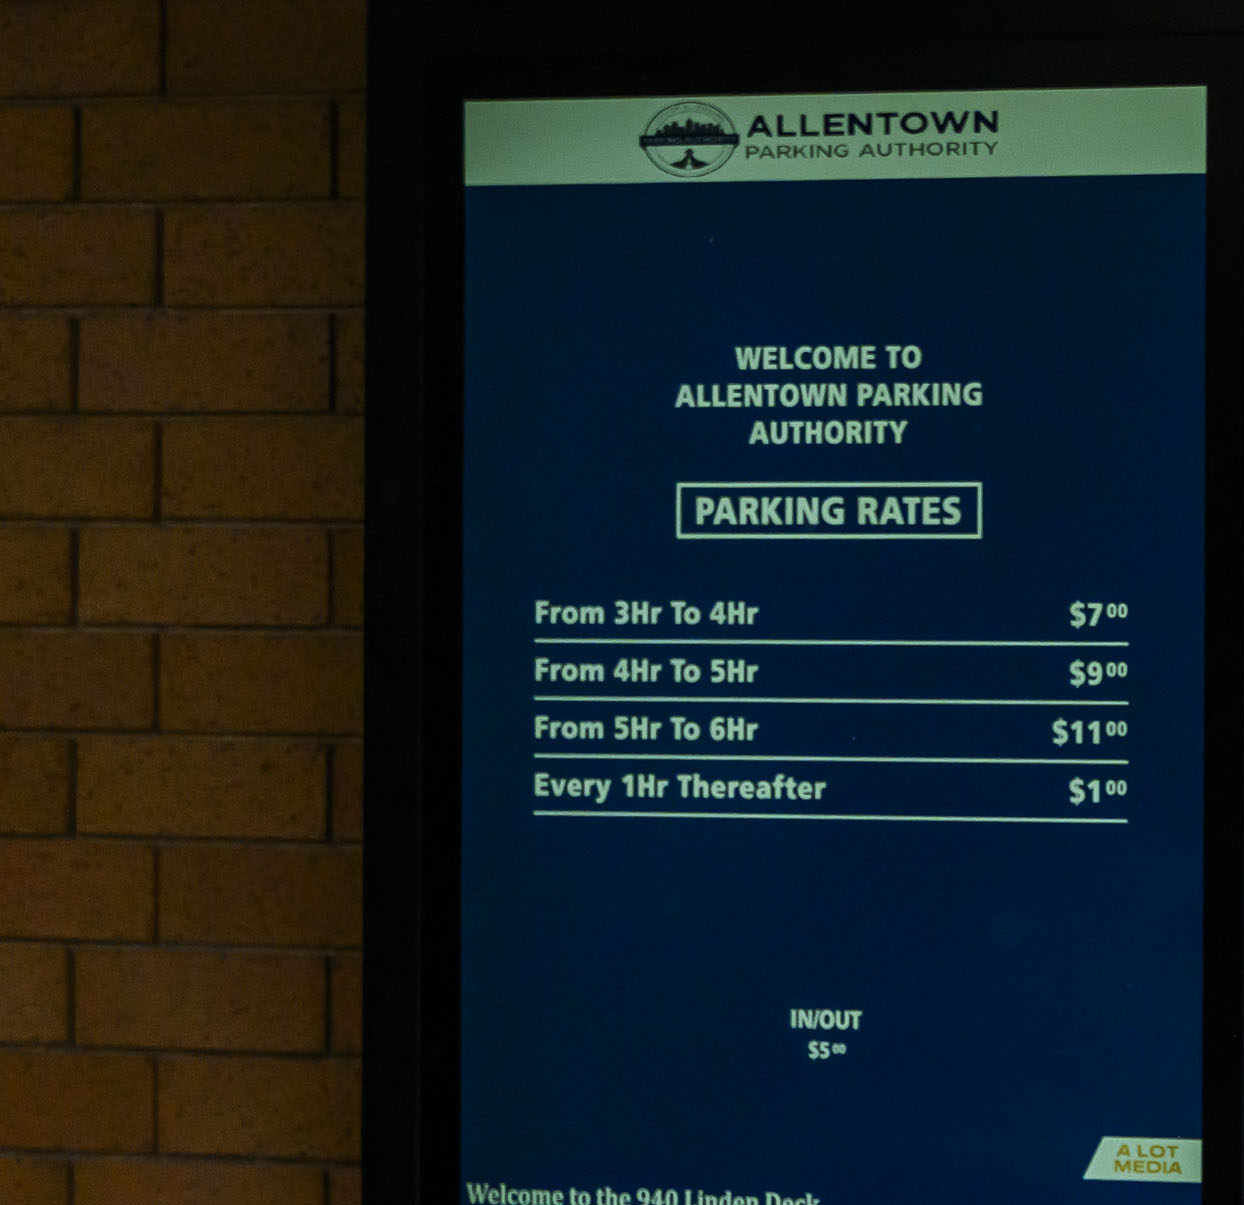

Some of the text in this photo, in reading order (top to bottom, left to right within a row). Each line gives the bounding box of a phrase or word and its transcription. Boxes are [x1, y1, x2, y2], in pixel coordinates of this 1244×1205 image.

[747, 111, 998, 137] ALLENTOWN
[746, 141, 998, 159] PARKING AUTHORITY
[735, 345, 921, 370] WELCOME TO
[675, 383, 982, 407] ALLENTOWN PARKING
[749, 421, 908, 444] AUTHORITY
[696, 497, 961, 525] PARKING RATES
[536, 600, 759, 624] From 3Hr To 4Hr
[535, 658, 758, 683] From 4Hr To 5Hr
[535, 716, 758, 740] From 5Hr To 6Hr
[535, 773, 826, 803] Every 1Hr Thereafter
[791, 1009, 862, 1030] IN/OUT
[1117, 1144, 1179, 1158] A LOT
[1115, 1160, 1182, 1174] MEDIA
